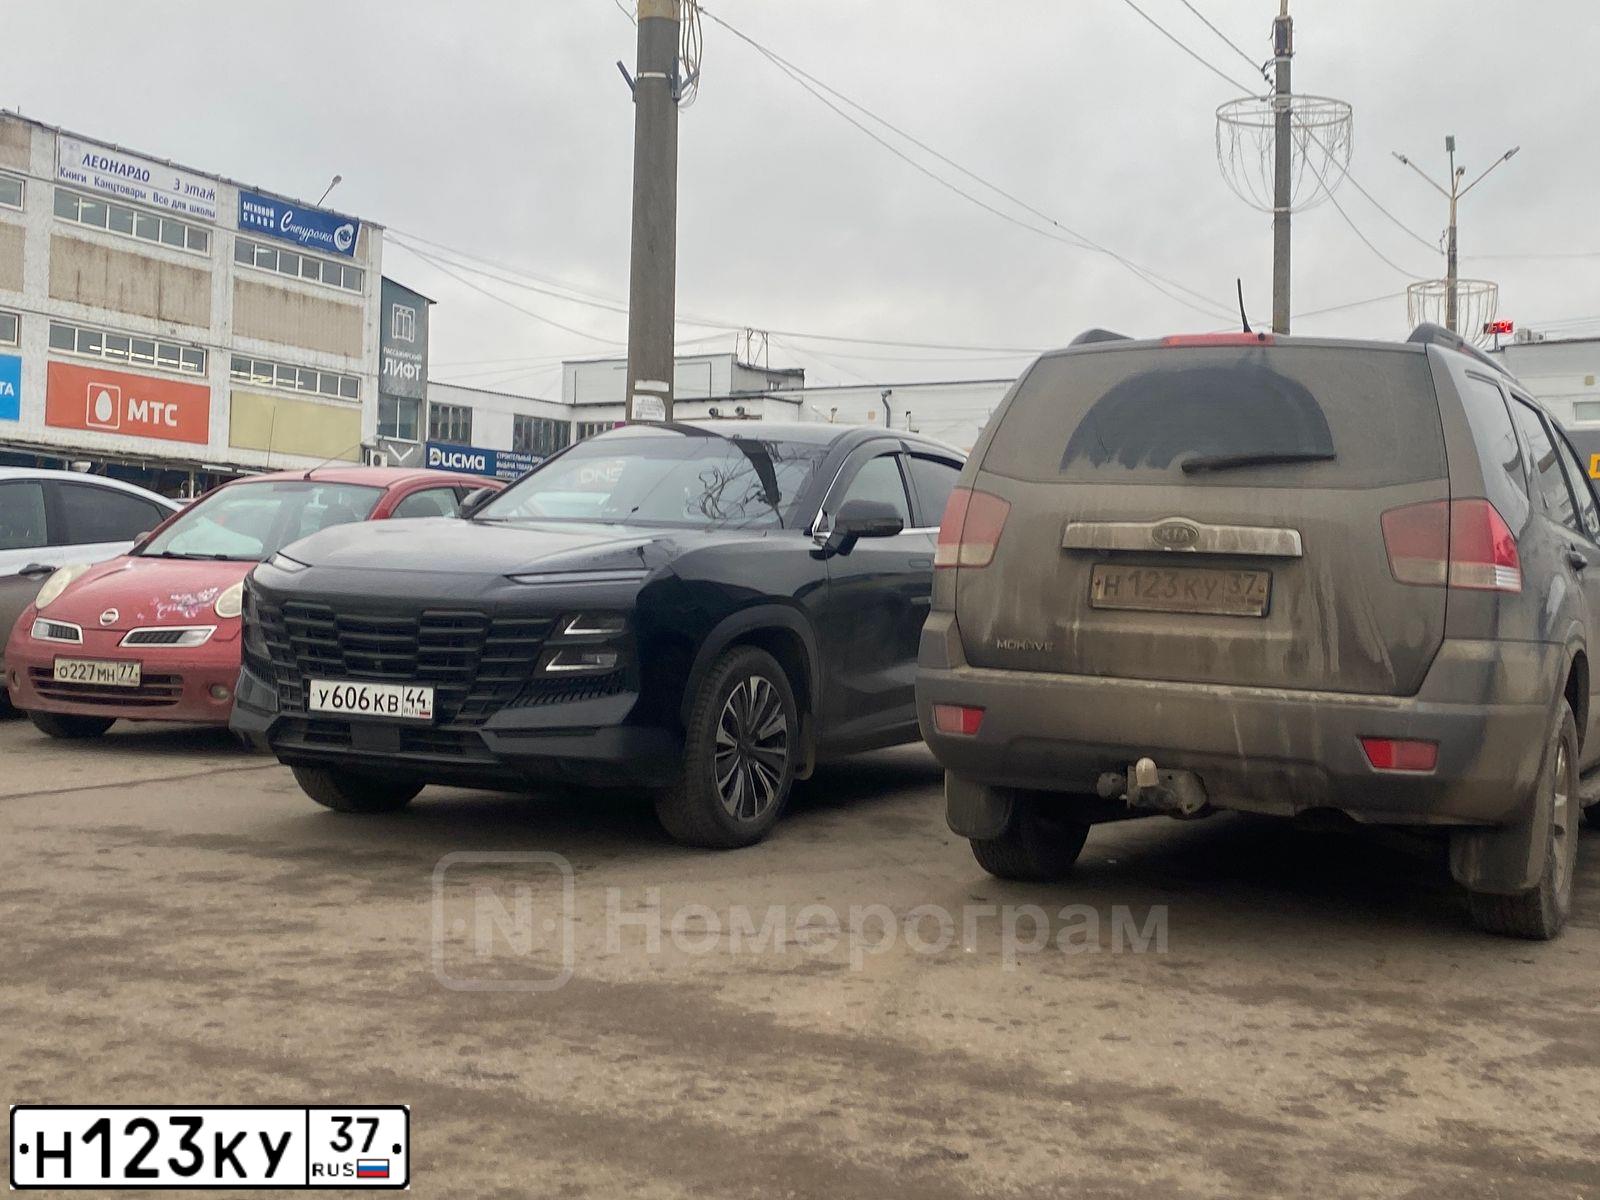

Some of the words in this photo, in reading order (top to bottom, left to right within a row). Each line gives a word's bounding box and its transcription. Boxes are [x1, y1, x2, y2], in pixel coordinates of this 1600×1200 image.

[82, 153, 150, 183] ЛЕОНАРДО
[59, 166, 87, 183] Книги
[94, 176, 147, 201] Канцтовары
[153, 191, 169, 205] Все
[171, 199, 187, 211] для
[189, 205, 216, 219] школы
[173, 178, 180, 190] 3
[184, 182, 216, 201] этаж
[383, 357, 422, 381] ЛИФТ
[128, 398, 178, 427] МТС
[1227, 572, 1258, 595] 37
[59, 663, 115, 681] О227МН
[119, 664, 135, 680] 77
[319, 685, 399, 713] У606КВ
[405, 689, 426, 709] 44
